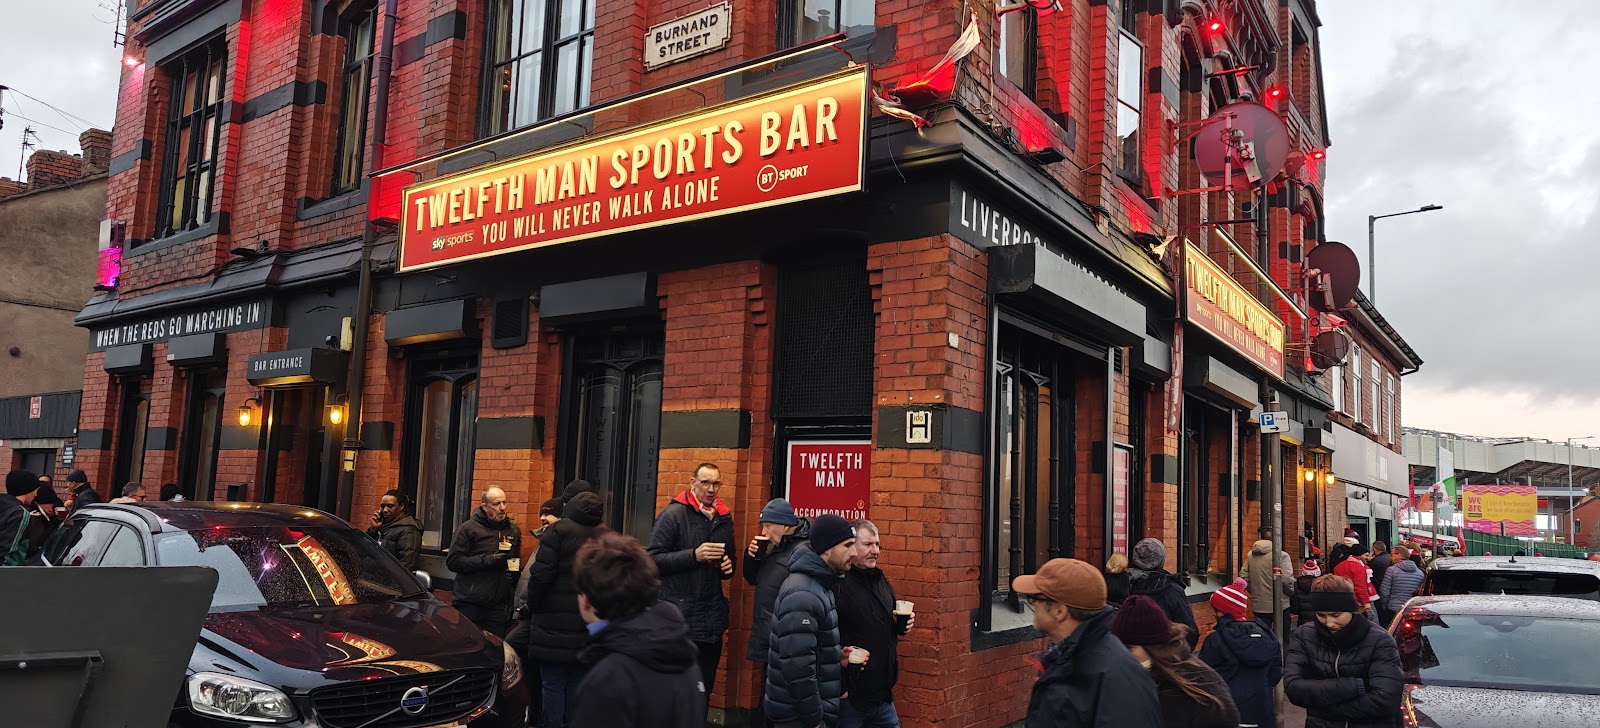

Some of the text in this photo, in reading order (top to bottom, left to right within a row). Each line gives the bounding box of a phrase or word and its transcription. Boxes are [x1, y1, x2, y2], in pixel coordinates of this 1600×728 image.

[655, 14, 719, 44] BURNAND
[659, 32, 711, 58] STREET
[414, 96, 839, 233] TWELFTH MAN SPORTS BAR
[761, 164, 809, 183] BT SPORT
[481, 176, 720, 246] YOU WILL NEVER WALK ALONE
[961, 191, 1047, 249] LIVERP
[432, 231, 474, 252] sky sports
[1188, 257, 1228, 313] TWELFTH
[1228, 288, 1245, 326] MAN
[96, 302, 260, 348] WHEN THE REDS GO MARCHING IN
[254, 356, 303, 372] BAR ENTRANCE
[909, 413, 929, 439] H
[1264, 415, 1272, 425] P
[800, 453, 863, 470] TWELFTH
[815, 471, 845, 488] MAN
[793, 507, 866, 520] ACCOMMODATION
